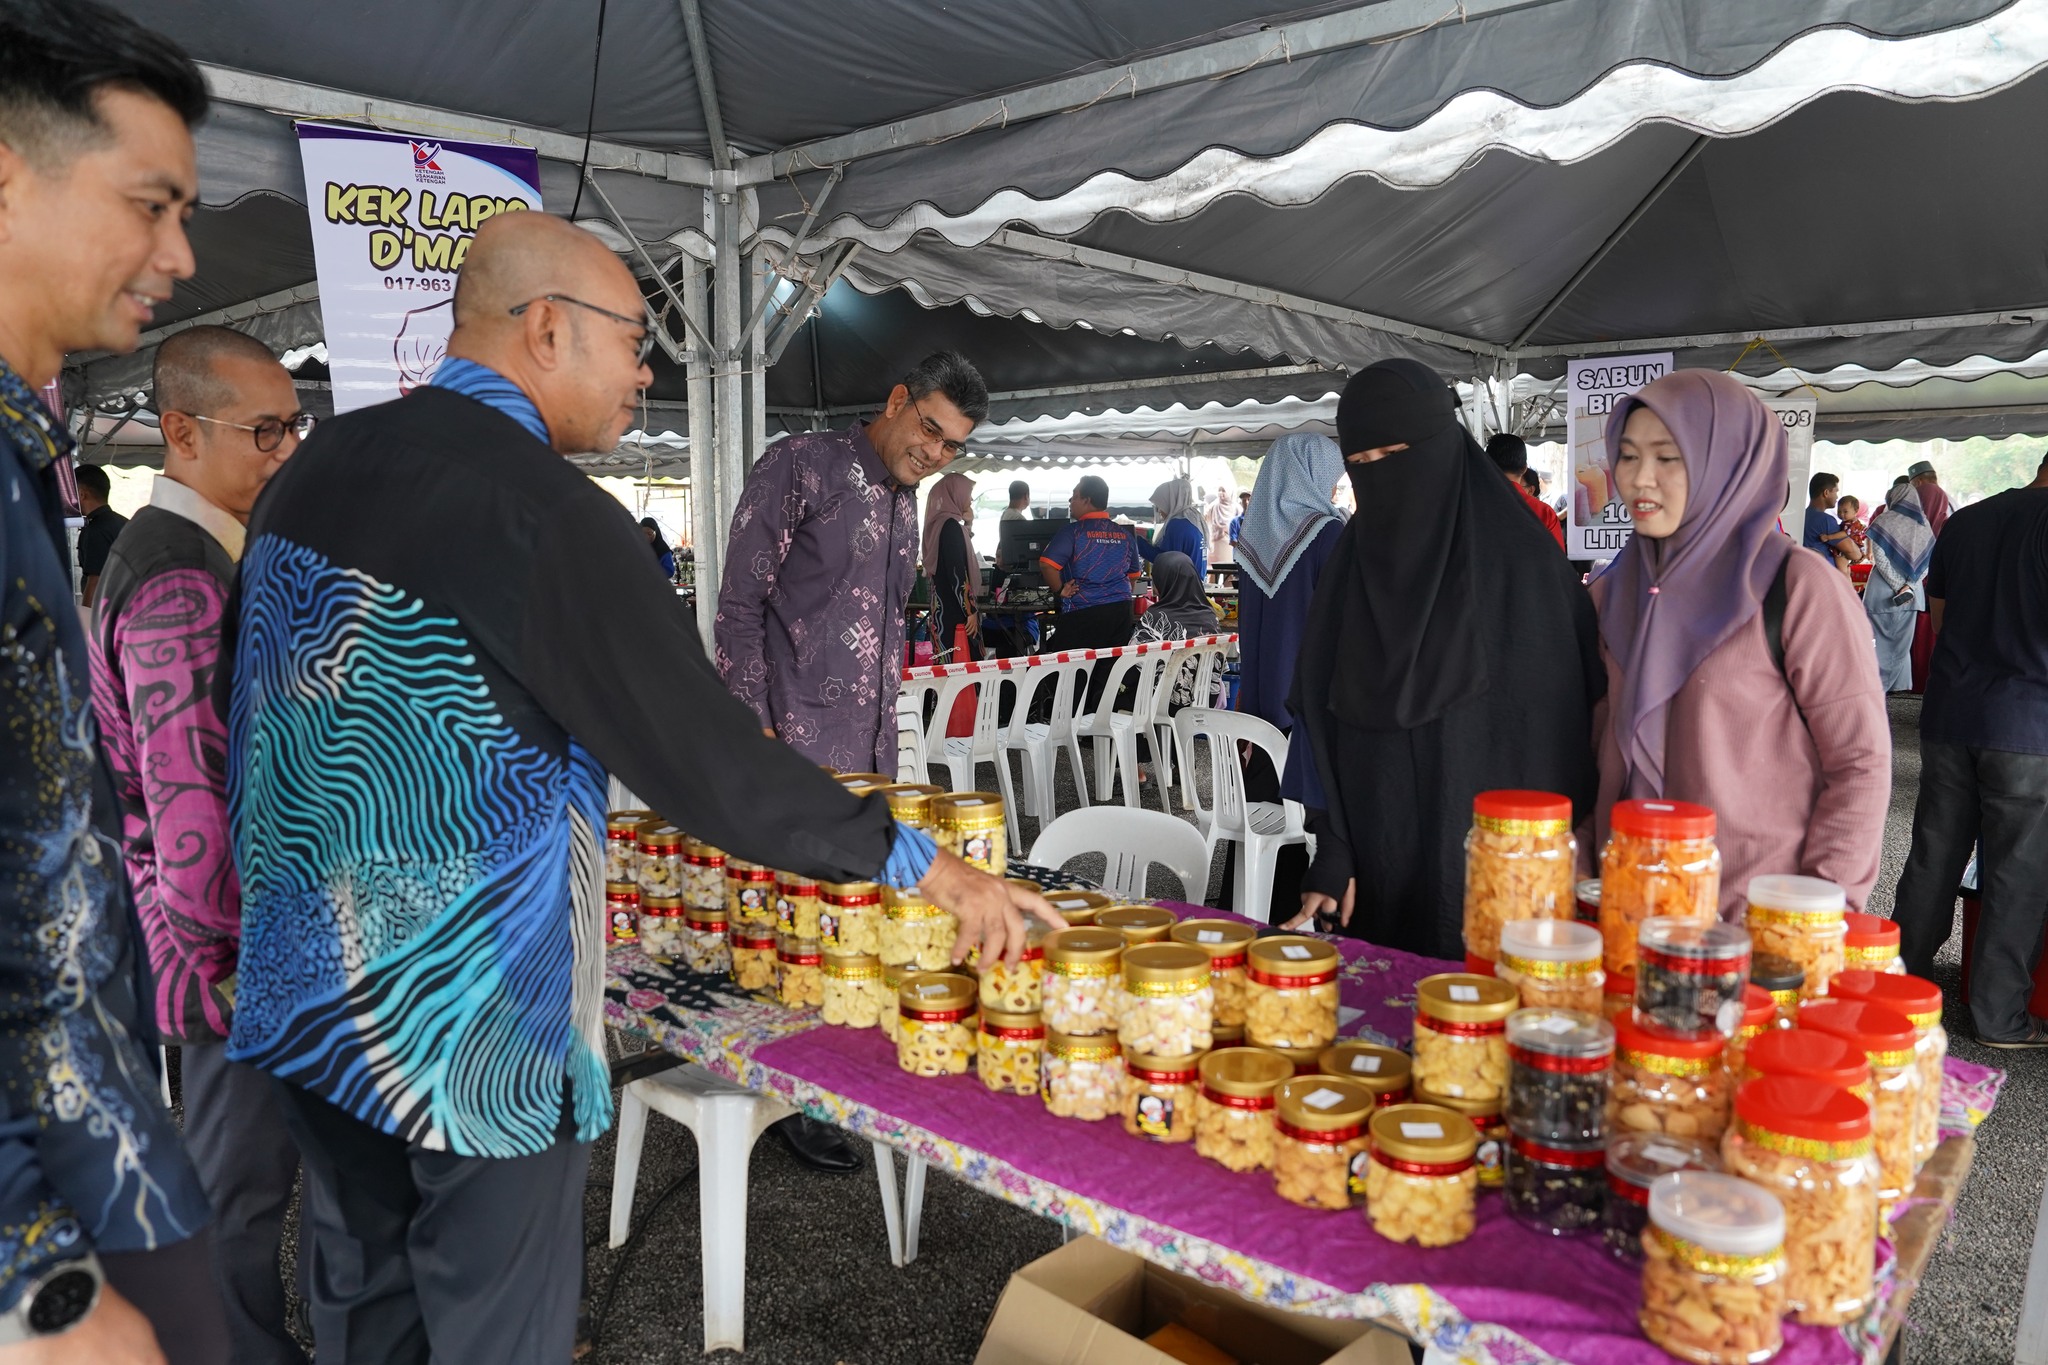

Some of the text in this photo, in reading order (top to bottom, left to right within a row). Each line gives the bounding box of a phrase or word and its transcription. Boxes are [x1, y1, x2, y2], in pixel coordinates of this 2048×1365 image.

[325, 181, 412, 228] KEK
[384, 276, 452, 292] 017-963
[1577, 363, 1664, 390] SABUN
